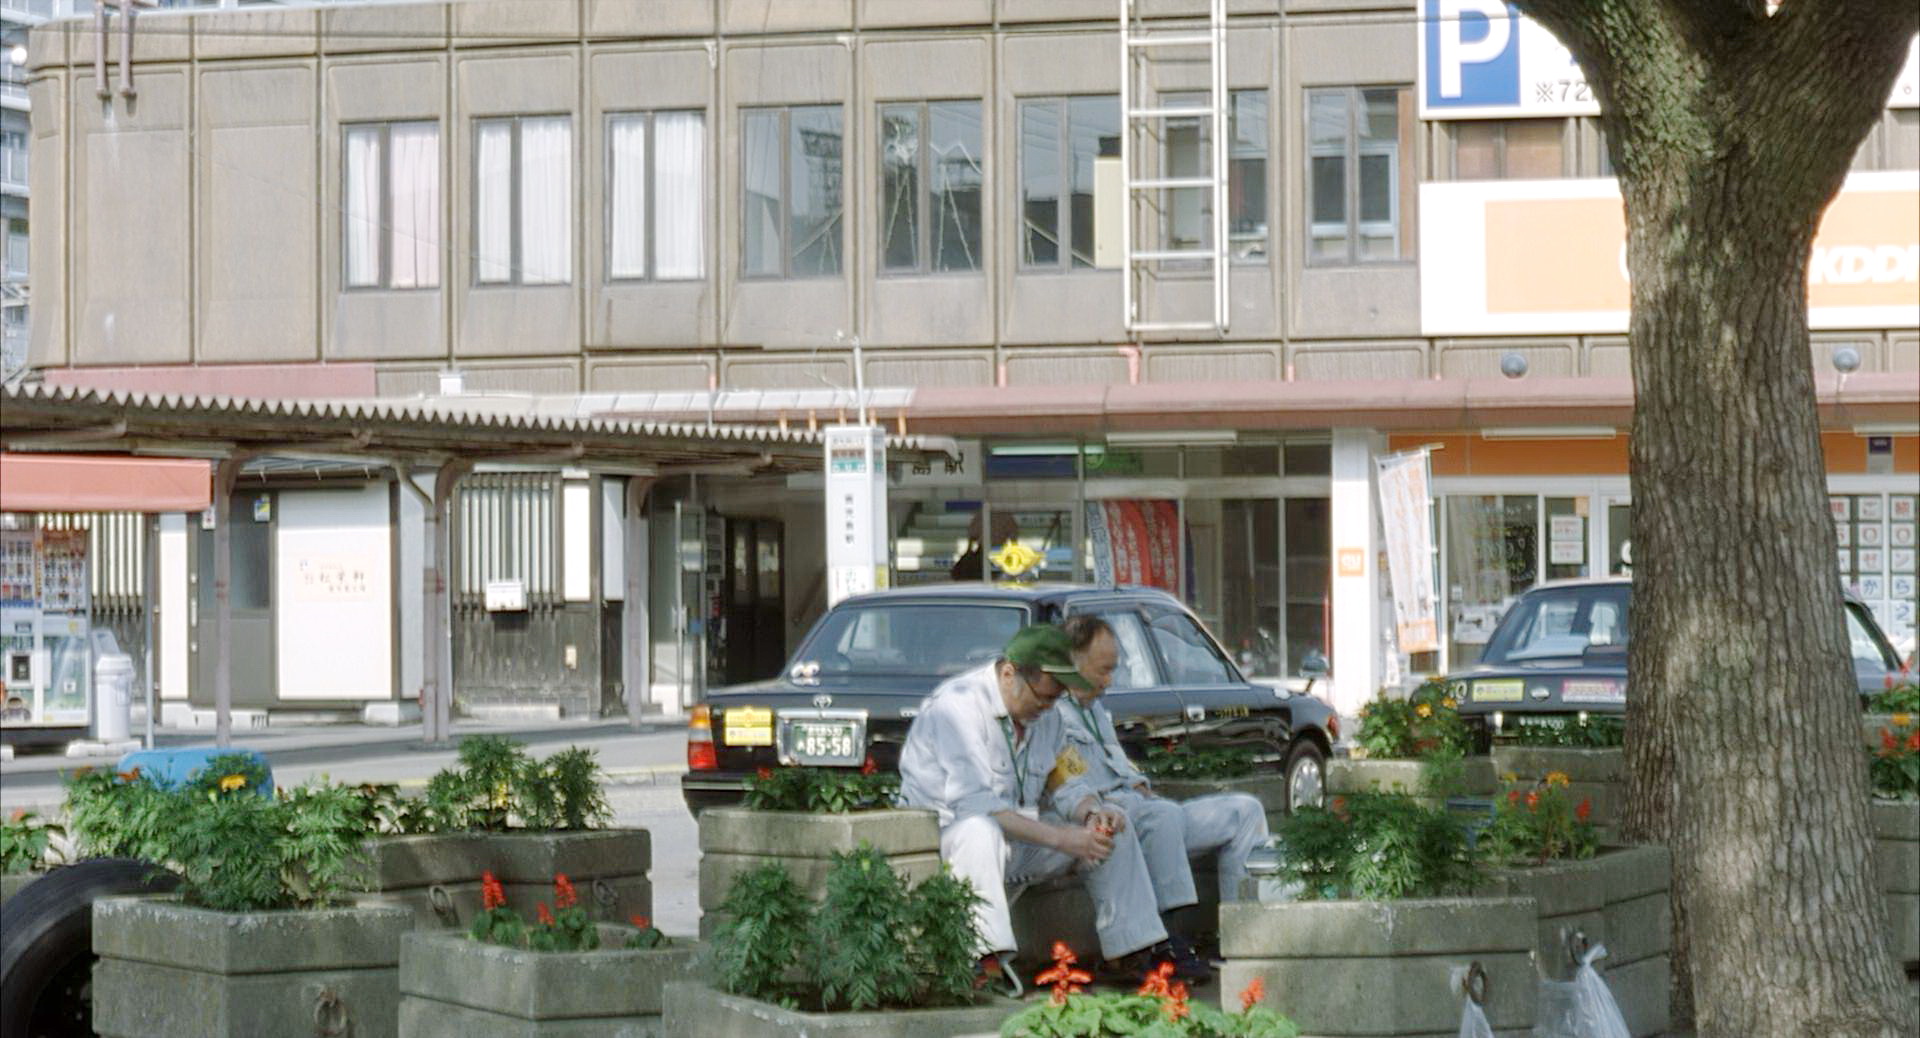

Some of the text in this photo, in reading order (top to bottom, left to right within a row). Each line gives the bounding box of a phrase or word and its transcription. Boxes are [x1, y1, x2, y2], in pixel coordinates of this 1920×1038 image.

[1440, 0, 1510, 98] P
[1808, 245, 1918, 284] KDDI
[806, 737, 851, 757] 85-58
